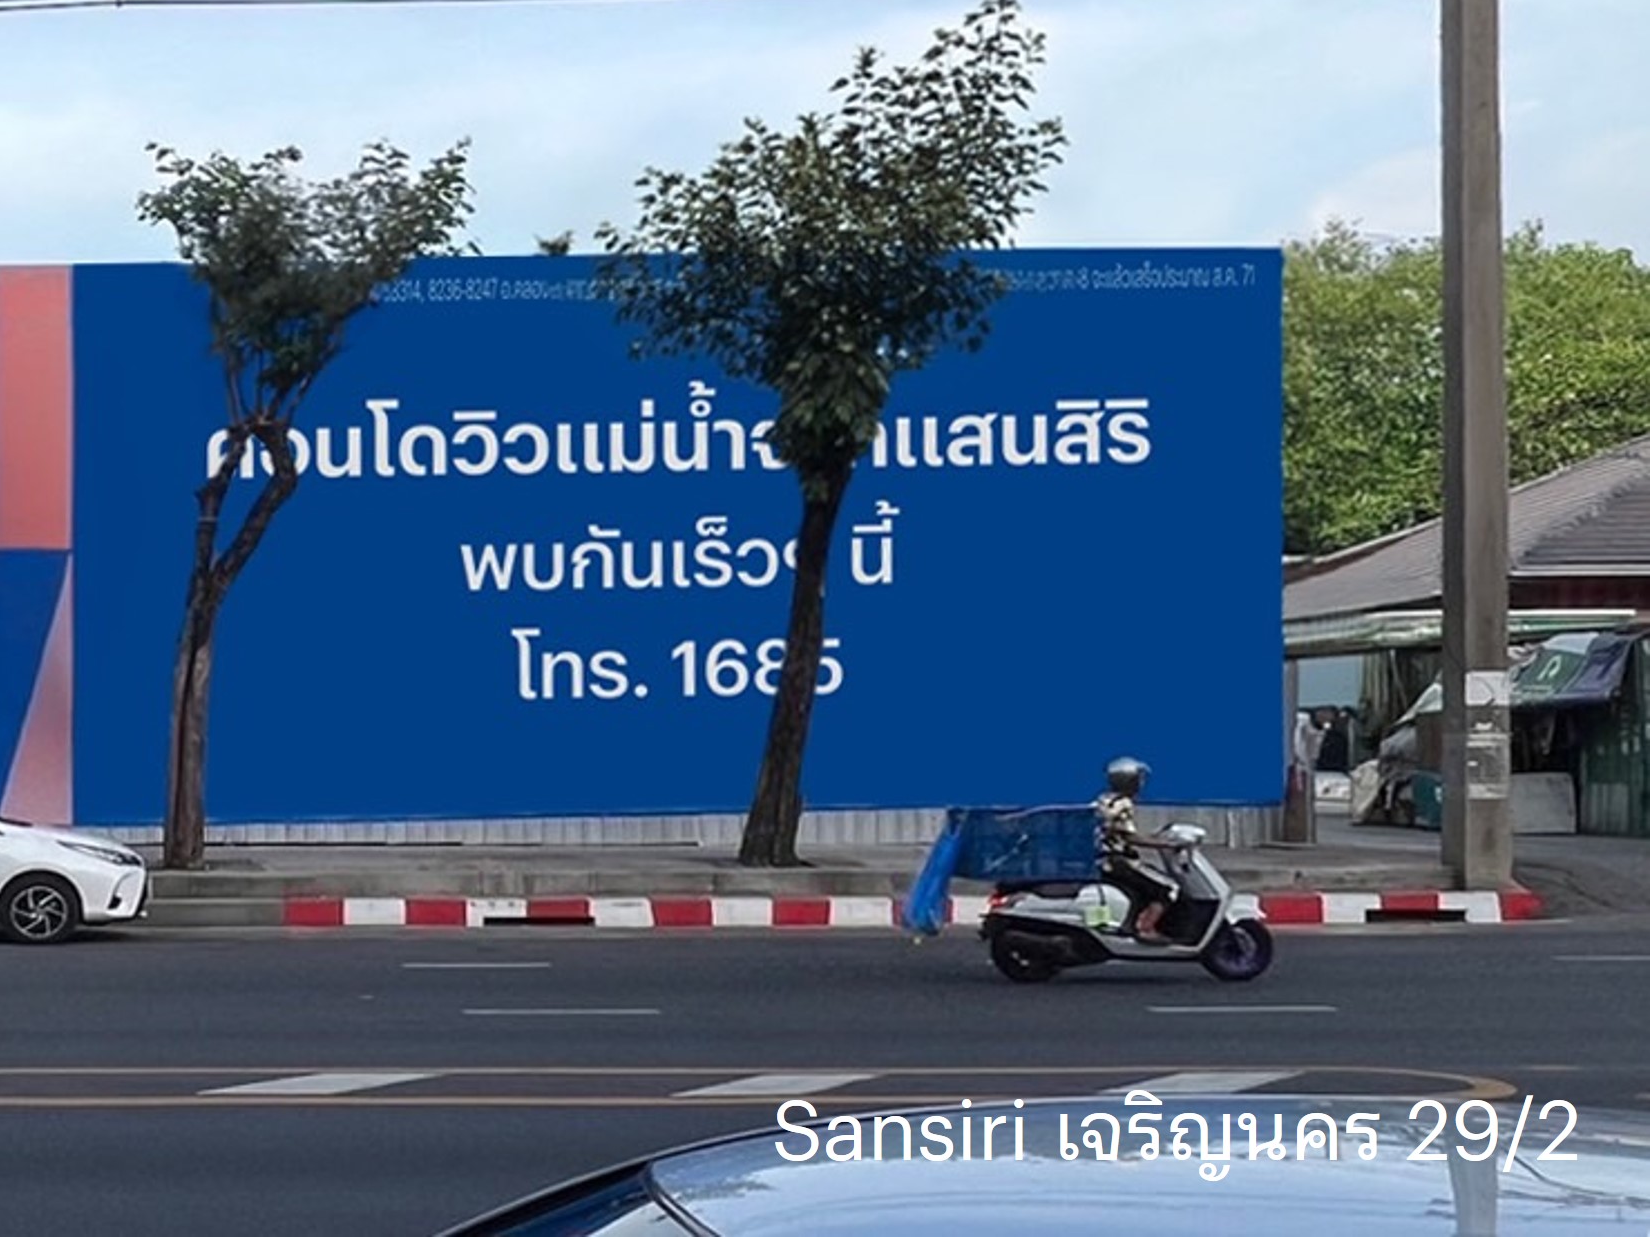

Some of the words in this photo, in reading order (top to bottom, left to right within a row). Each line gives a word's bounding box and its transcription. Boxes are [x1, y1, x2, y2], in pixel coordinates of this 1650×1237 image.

[207, 380, 1151, 478] คอนโดวิวแม่น้ำจแสนสิริ
[851, 500, 900, 585] นี้
[511, 628, 648, 699] โทร.
[671, 638, 844, 697] 1685
